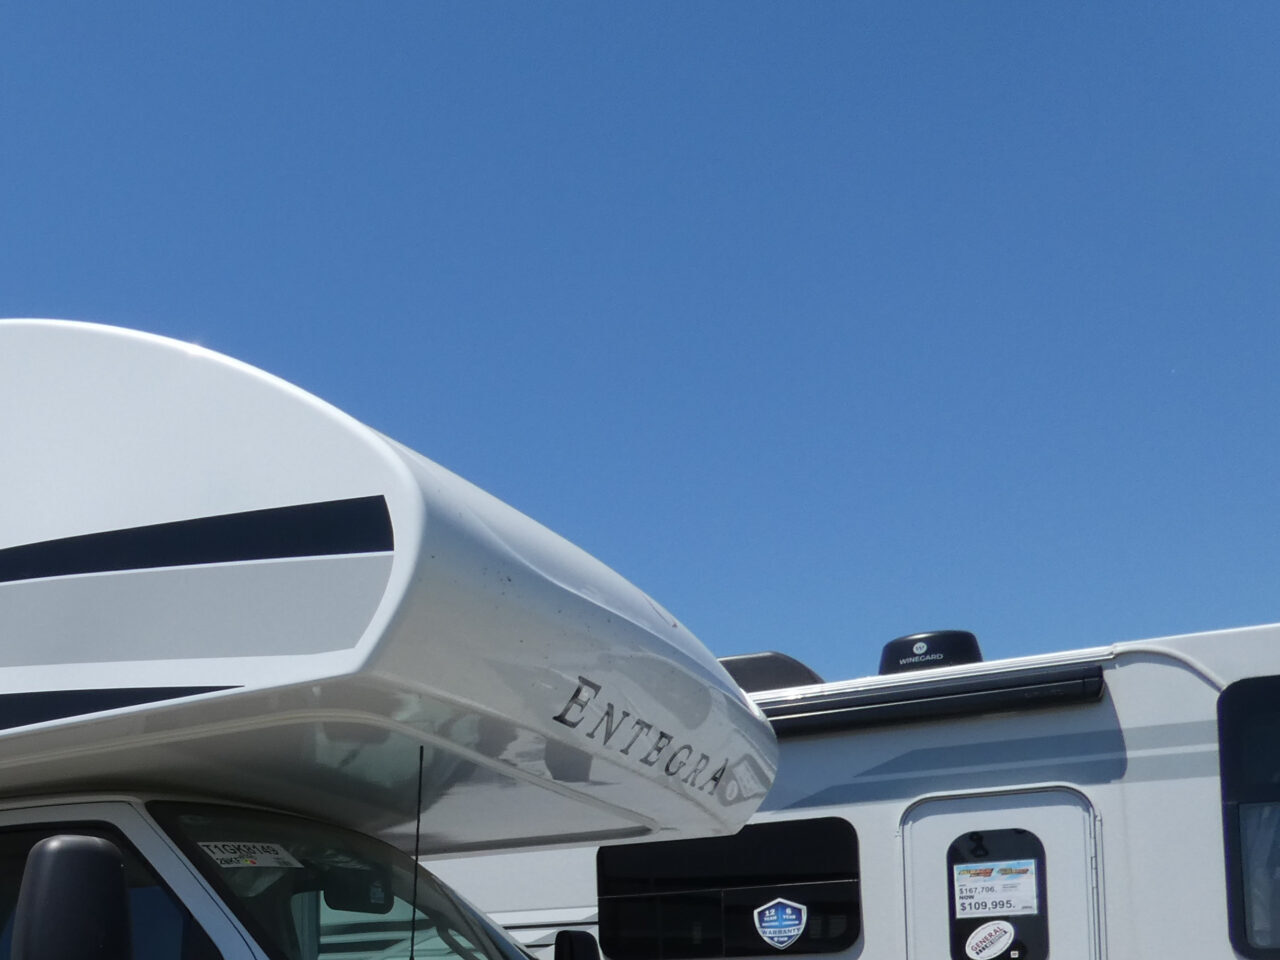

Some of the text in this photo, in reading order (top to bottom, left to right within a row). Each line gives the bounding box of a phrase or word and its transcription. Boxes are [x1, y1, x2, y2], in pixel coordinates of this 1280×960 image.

[899, 653, 944, 665] WINEGARD
[552, 675, 729, 796] ENTEGRA
[765, 909, 776, 917] 12
[970, 926, 1004, 951] GENERAL
